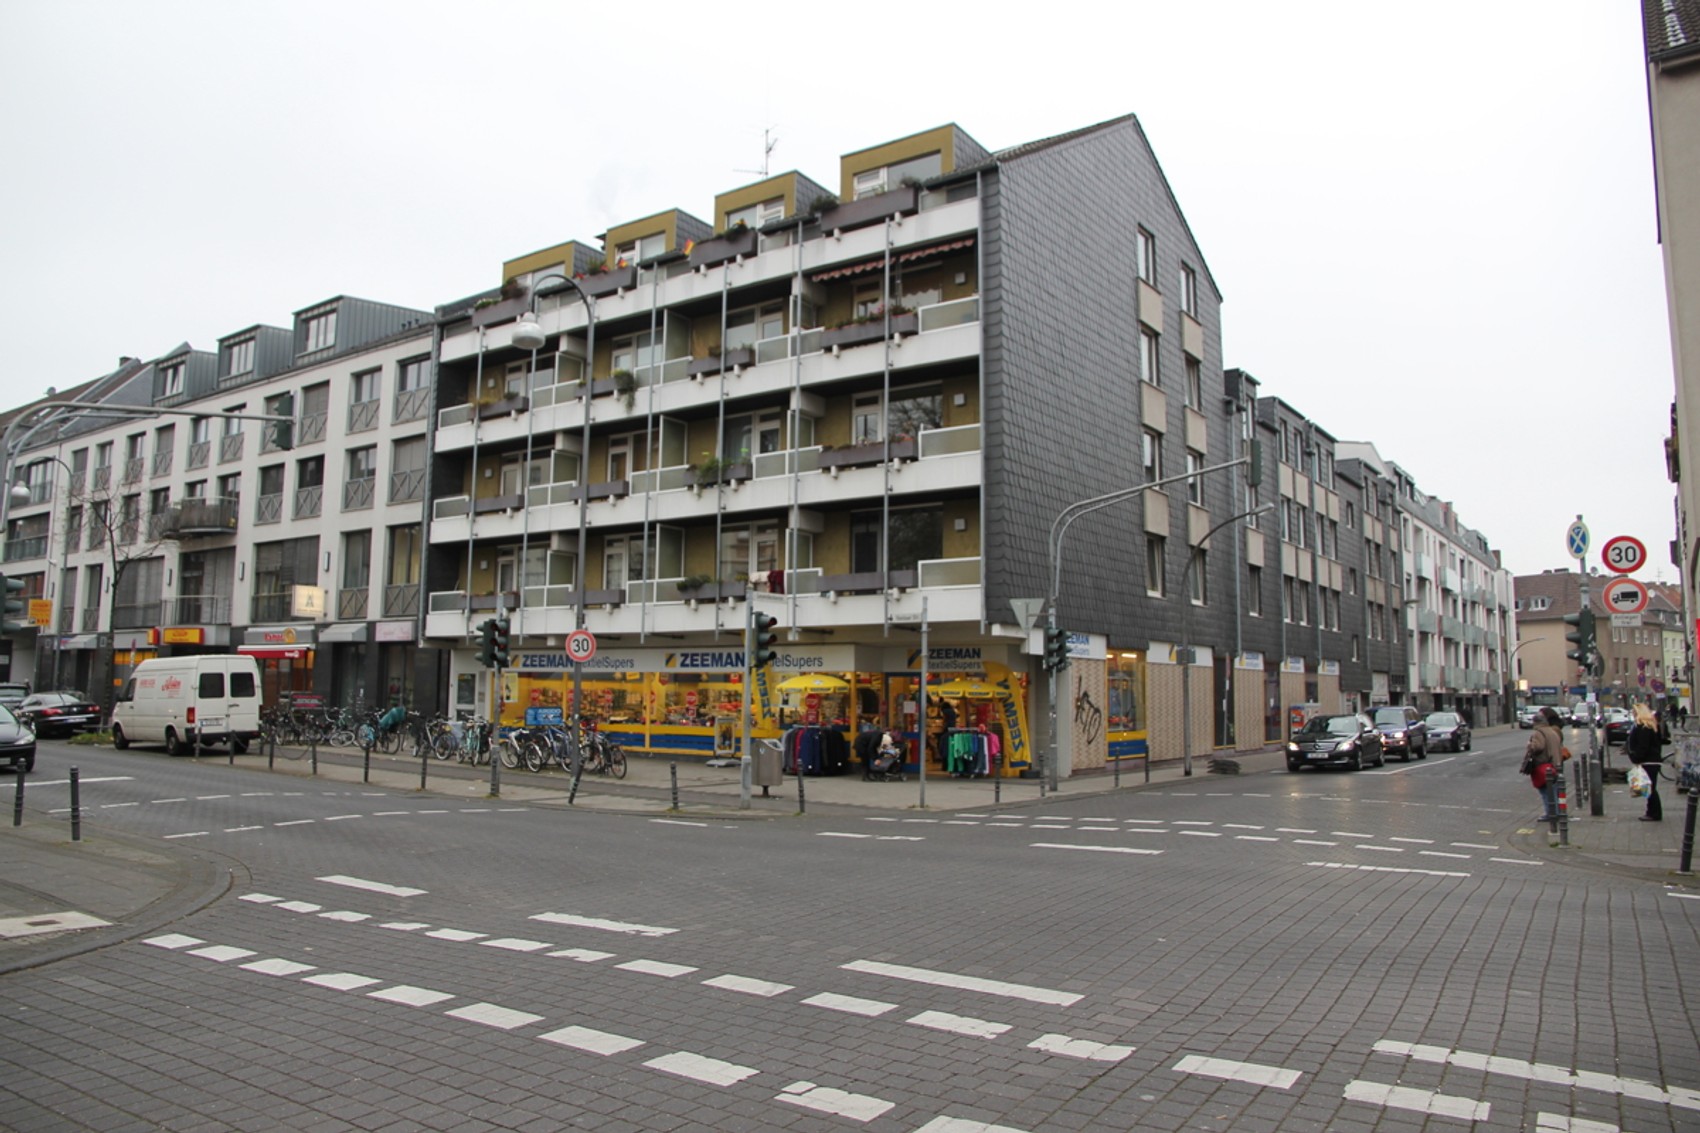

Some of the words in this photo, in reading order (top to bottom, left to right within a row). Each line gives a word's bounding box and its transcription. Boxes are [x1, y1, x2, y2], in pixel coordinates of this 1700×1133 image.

[1611, 546, 1637, 564] 30
[572, 638, 589, 653] 30
[522, 654, 574, 668] ZEEMAN
[680, 652, 745, 668] ZEEMAN
[771, 654, 823, 670] ielSupers
[929, 648, 982, 659] ZEEMAN
